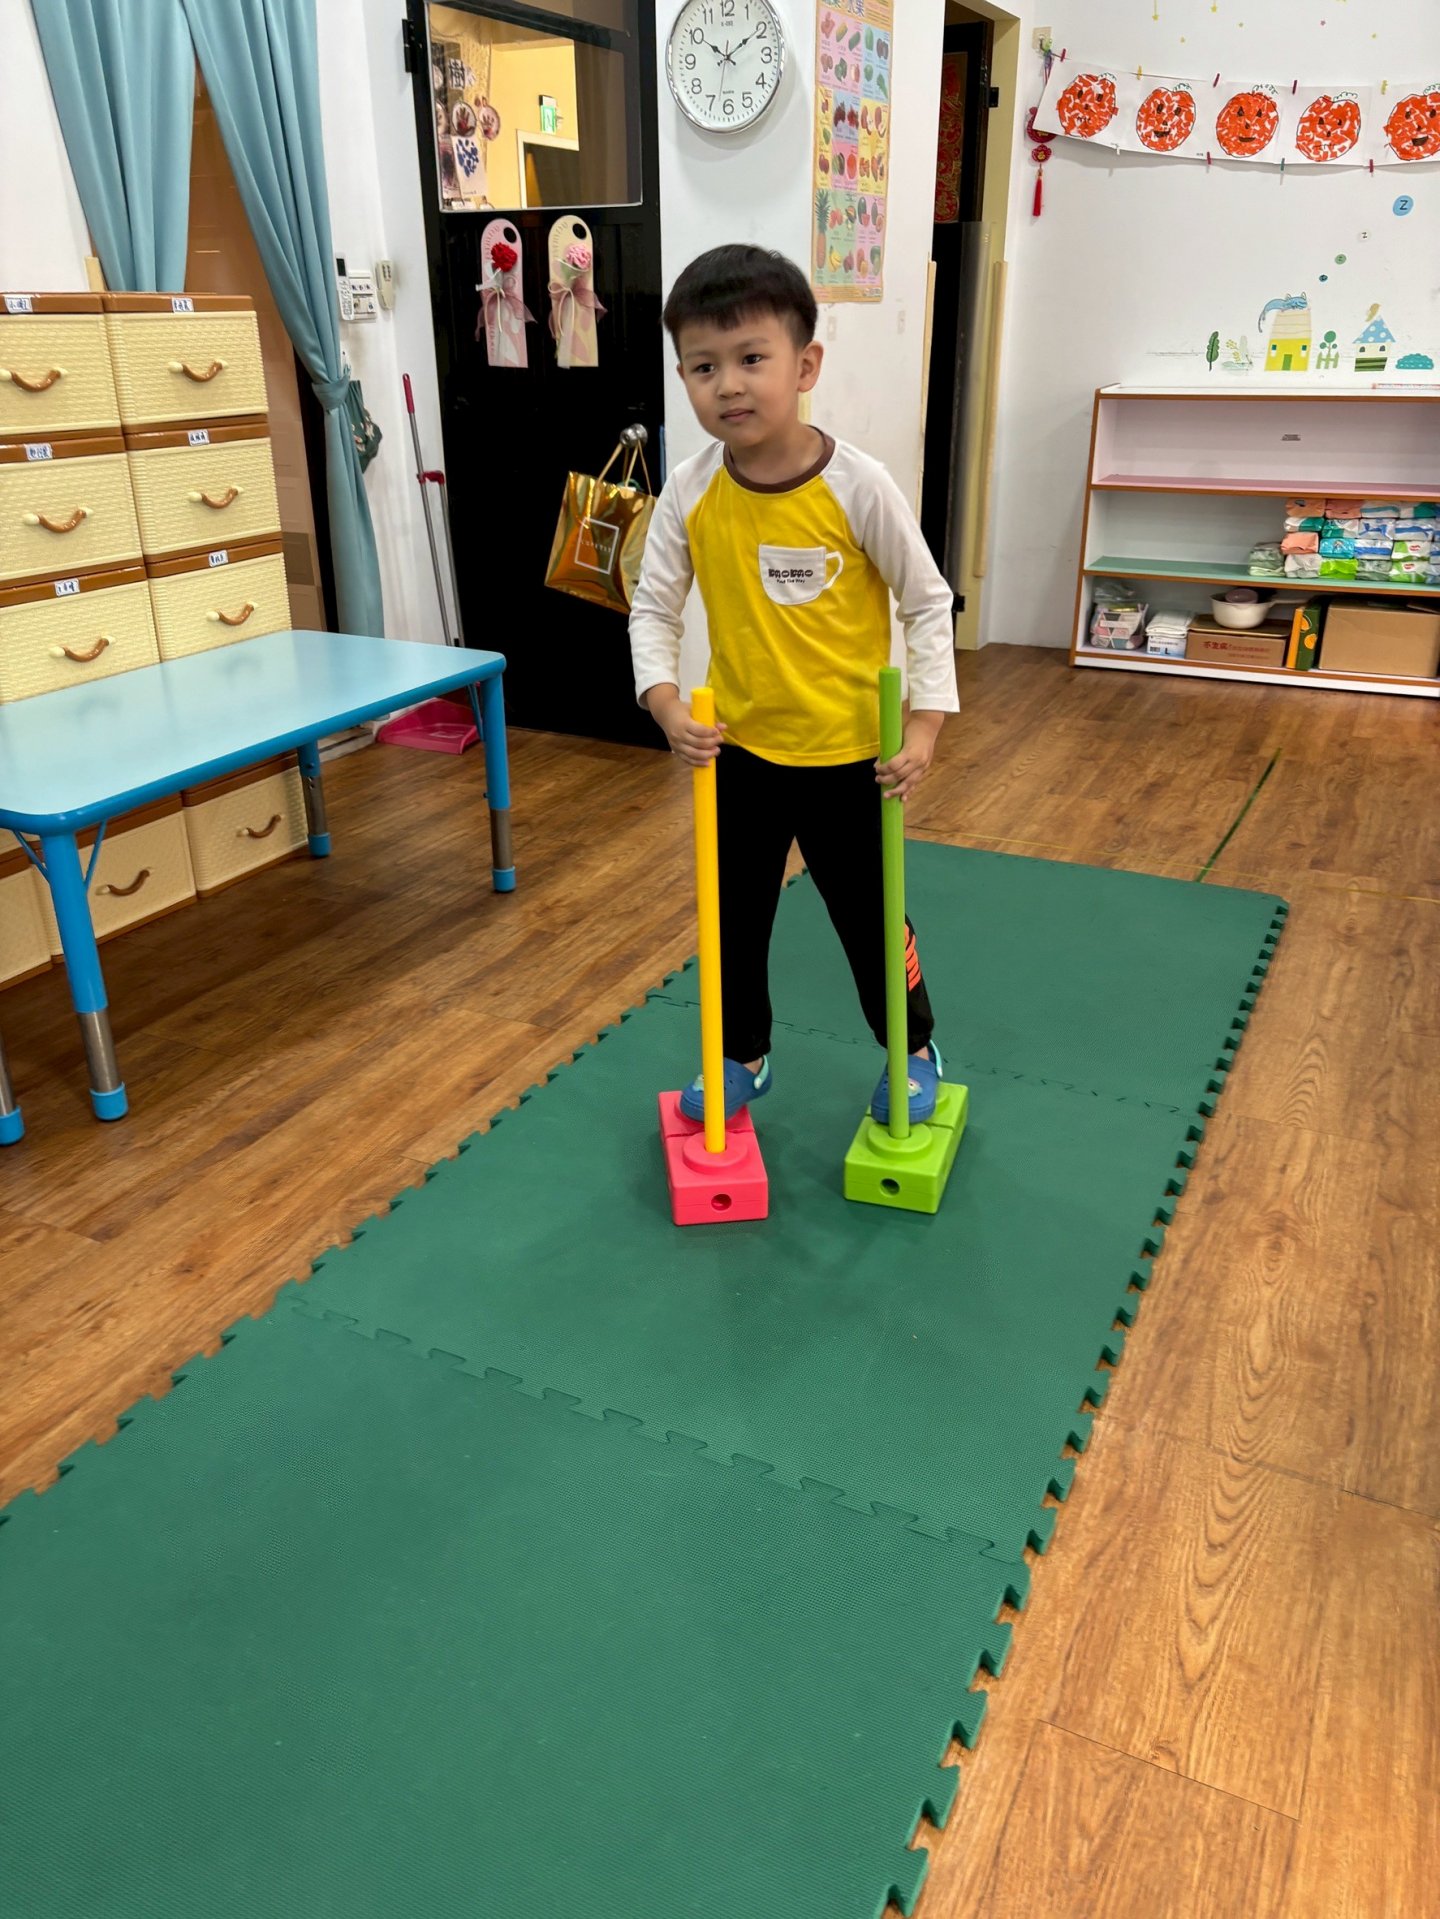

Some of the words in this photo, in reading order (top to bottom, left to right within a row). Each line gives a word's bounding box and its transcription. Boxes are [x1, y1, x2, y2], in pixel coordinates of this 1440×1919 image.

[702, 8, 713, 25] 11
[720, 0, 735, 17] 12
[744, 3, 749, 21] 1
[689, 27, 704, 45] 10
[755, 21, 768, 39] 2
[684, 53, 696, 70] 9
[760, 46, 772, 64] 3
[691, 78, 702, 95] 8
[755, 72, 767, 89] 4
[706, 95, 716, 111] 7
[722, 98, 734, 115] 6
[741, 92, 753, 109] 5
[1399, 199, 1408, 211] Z
[1164, 647, 1170, 655] L
